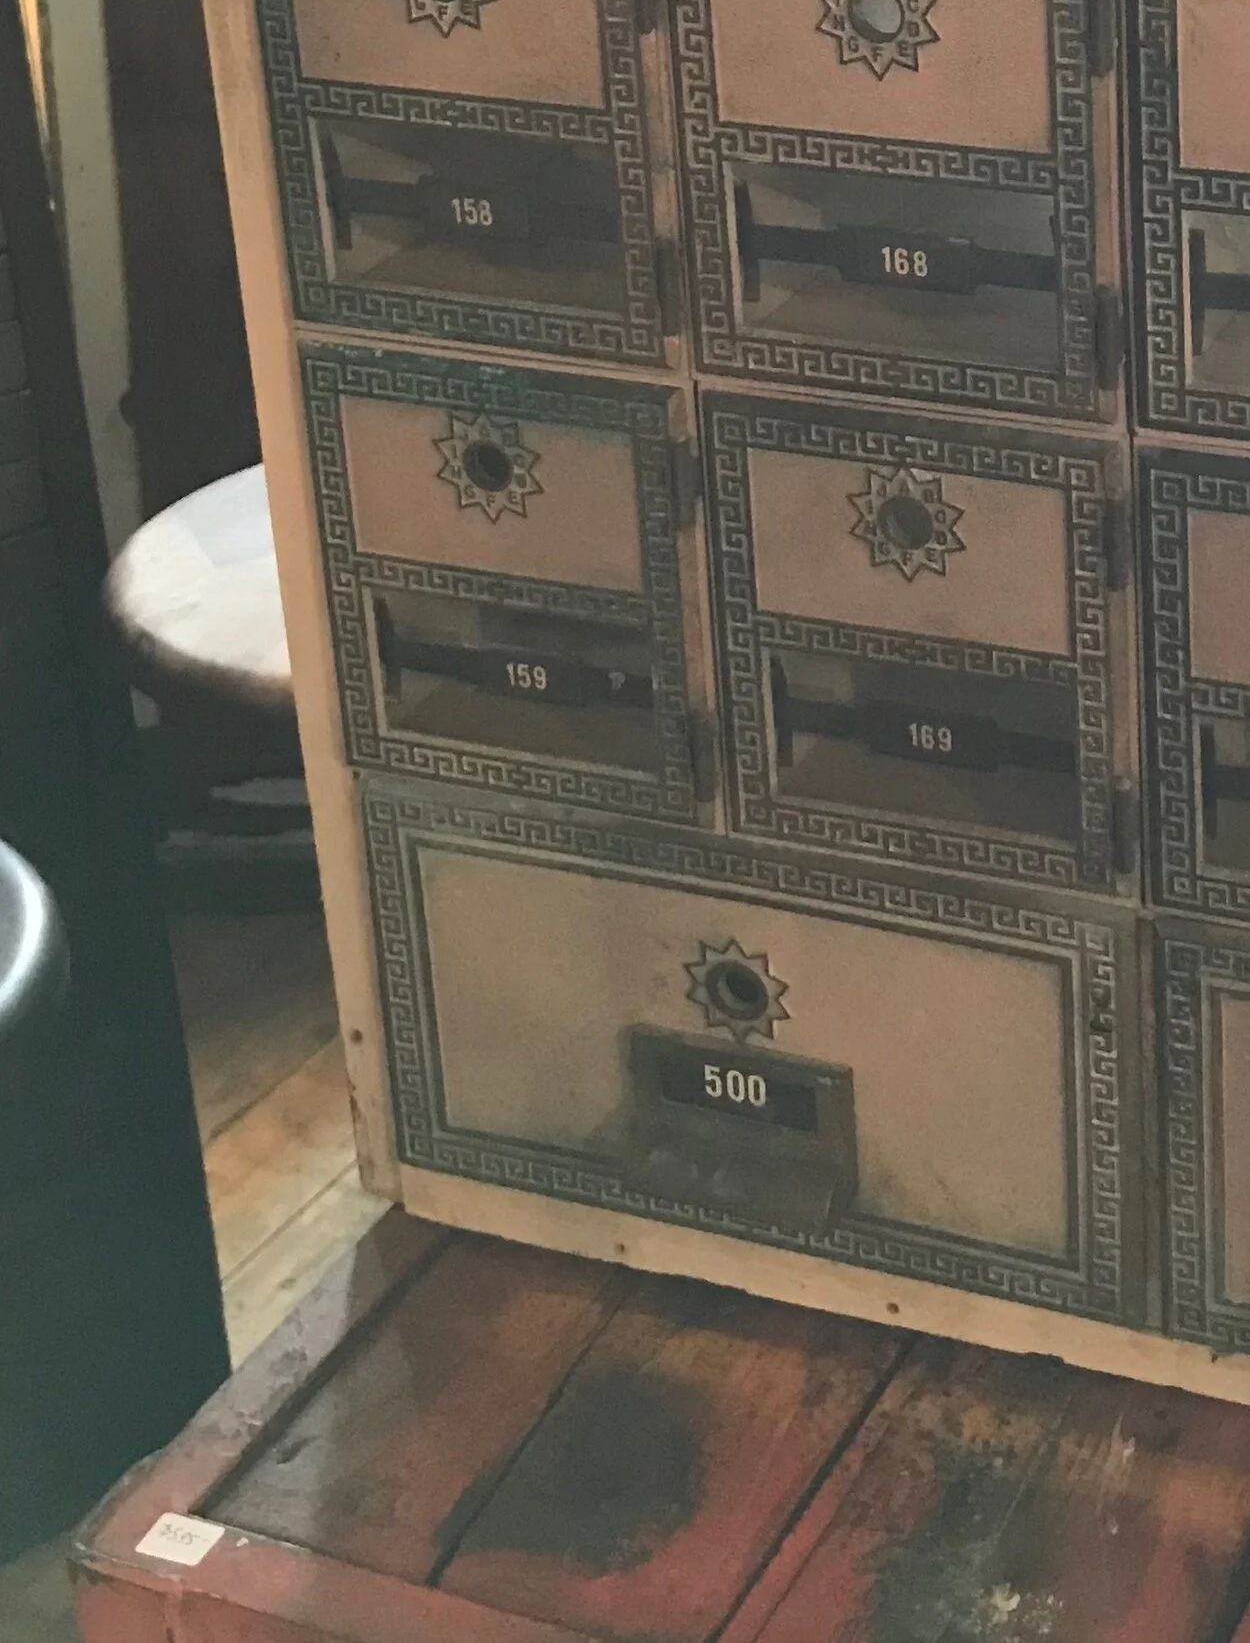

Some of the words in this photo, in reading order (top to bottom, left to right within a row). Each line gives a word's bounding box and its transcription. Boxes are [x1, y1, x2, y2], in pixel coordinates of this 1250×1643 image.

[451, 198, 493, 226] 158
[881, 246, 927, 277] 168
[506, 662, 546, 690] 159
[909, 723, 952, 751] 169
[704, 1064, 766, 1107] 500
